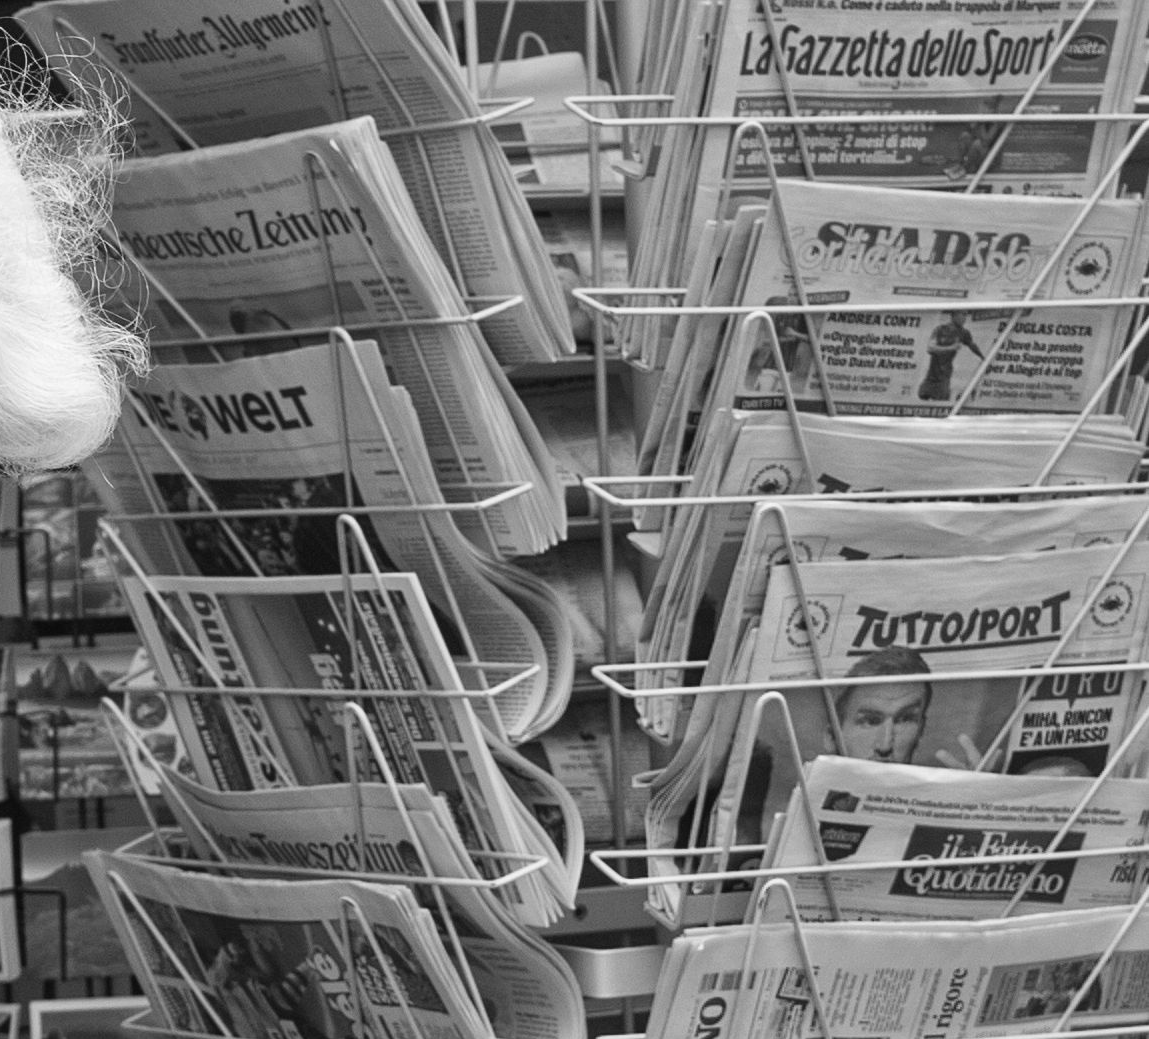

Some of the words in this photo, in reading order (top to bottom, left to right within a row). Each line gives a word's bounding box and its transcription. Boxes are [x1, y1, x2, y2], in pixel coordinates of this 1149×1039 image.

[740, 31, 774, 77] La
[777, 24, 910, 78] Gazzetta
[910, 30, 976, 78] dello
[973, 28, 1054, 85] Sport
[827, 312, 880, 326] ANDREA
[883, 315, 921, 328] CONTI
[998, 322, 1054, 336] DUGLAS
[1055, 325, 1092, 338] COSTA
[881, 335, 914, 347] Milan
[851, 591, 1071, 649] TUTTOSPORT
[1063, 708, 1113, 726] RINCON
[1044, 730, 1064, 746] UN
[1065, 727, 1108, 744] PASSO
[974, 831, 1044, 866] Fatto
[903, 855, 1064, 896] Quotidiano
[934, 968, 969, 1028] rigore
